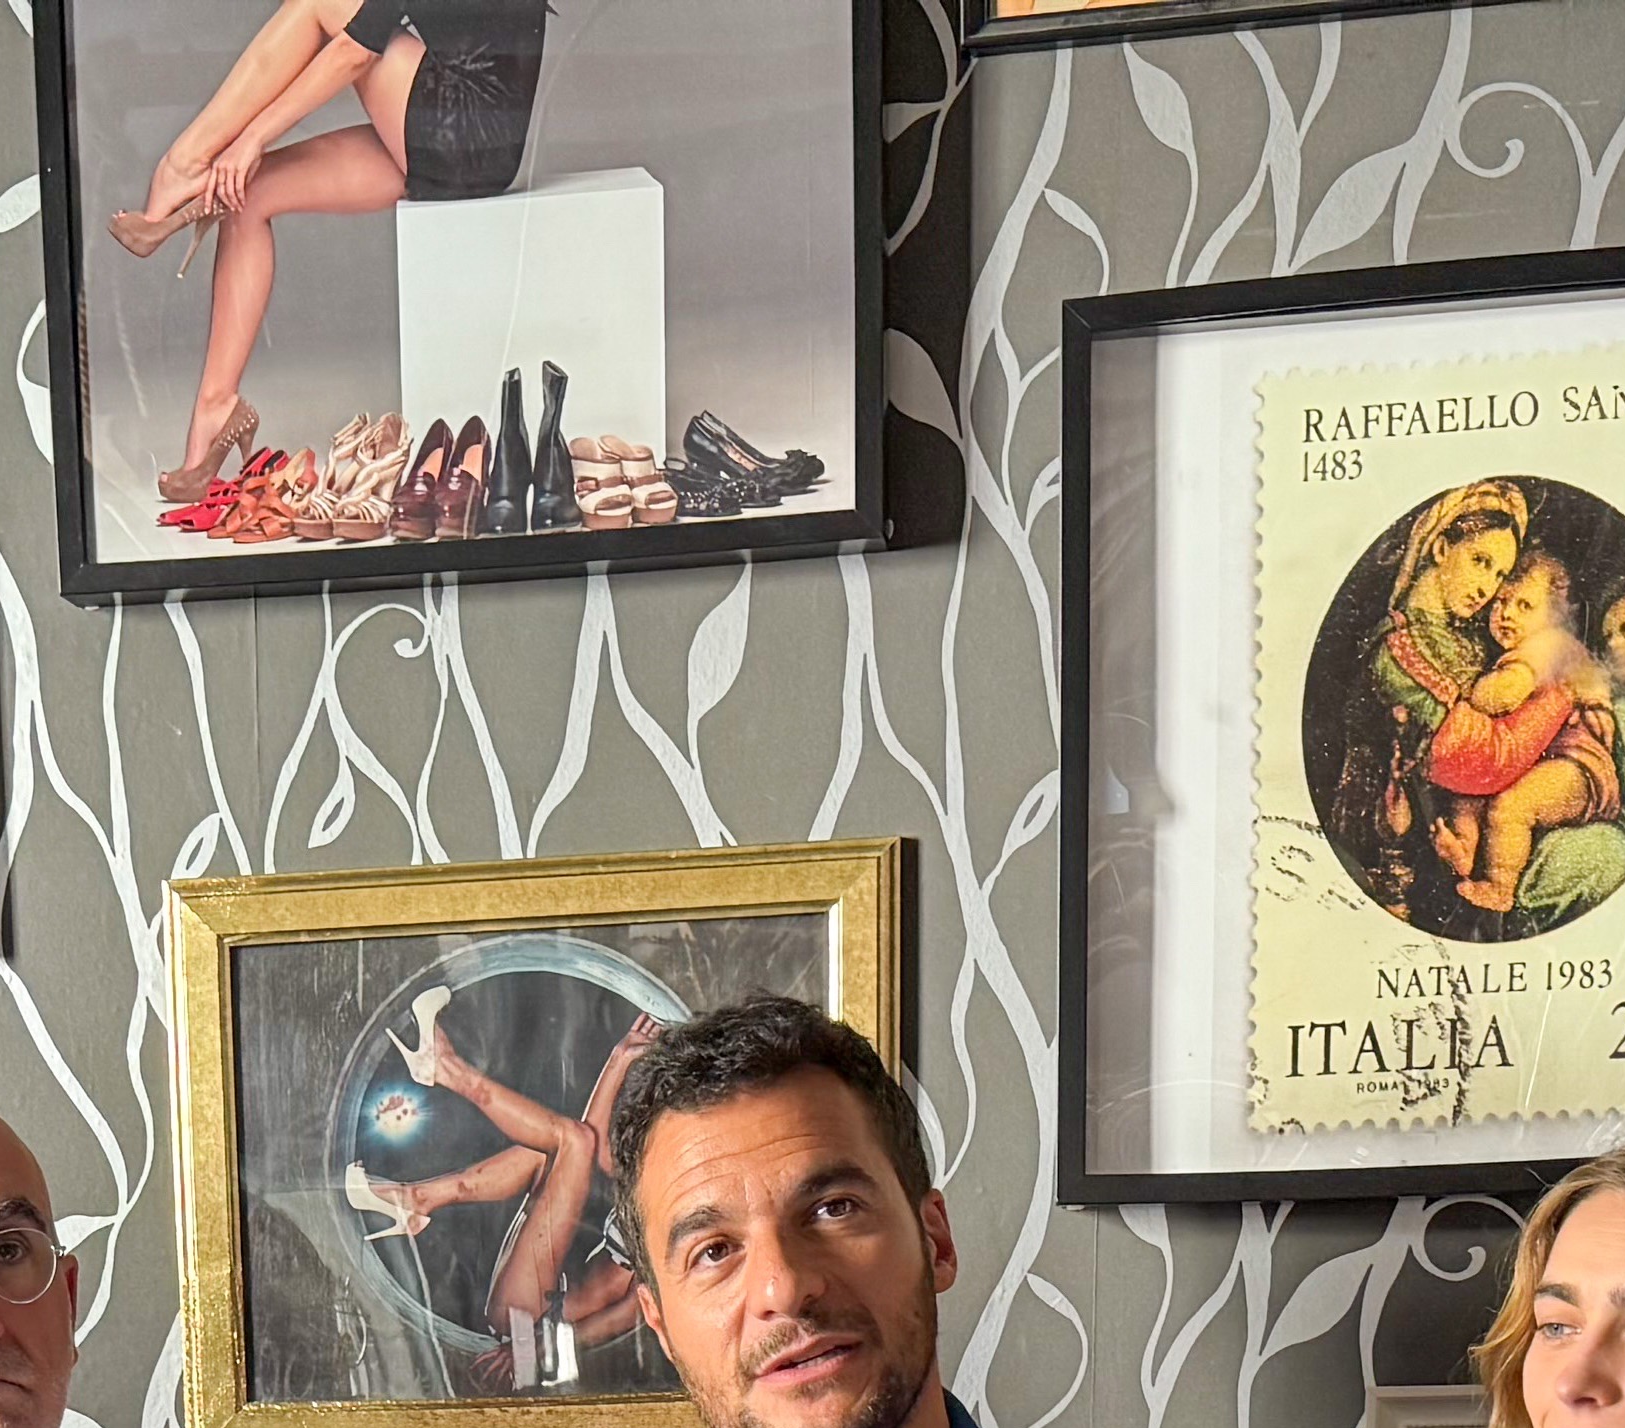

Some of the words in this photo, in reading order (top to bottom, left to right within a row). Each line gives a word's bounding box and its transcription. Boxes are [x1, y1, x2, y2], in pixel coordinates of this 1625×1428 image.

[1302, 390, 1540, 444] RAFFAELLO
[1302, 448, 1364, 483] 1483
[1376, 961, 1528, 999] NATALE
[1546, 958, 1614, 991] 1983
[1284, 1013, 1515, 1078] ITALIA
[1356, 1080, 1400, 1094] ROMA
